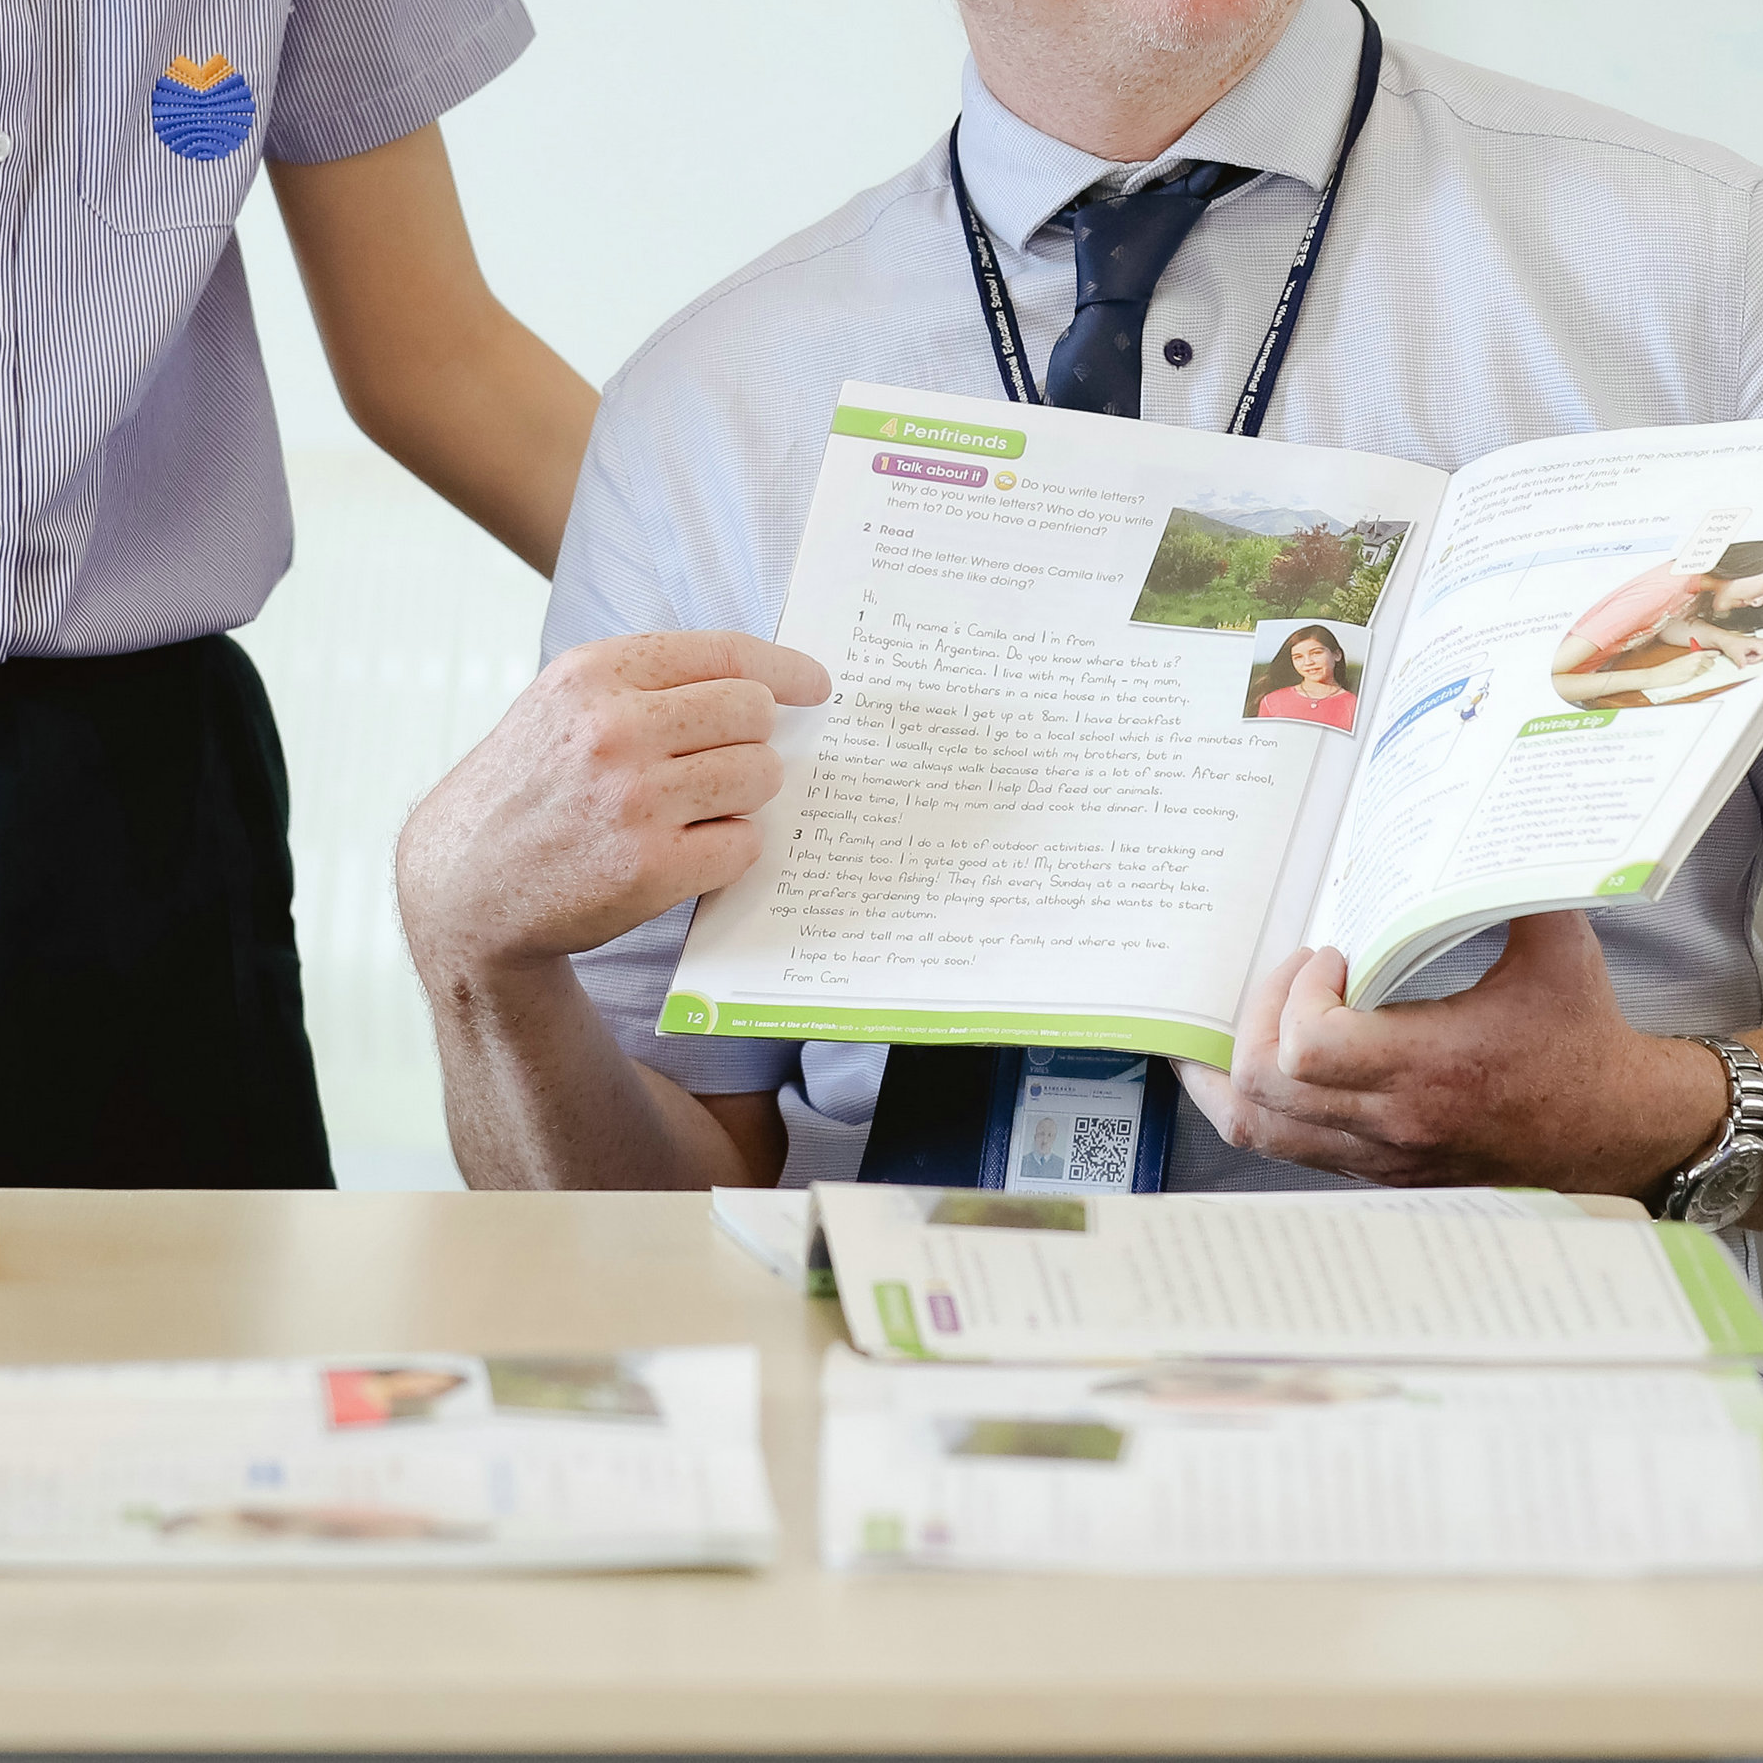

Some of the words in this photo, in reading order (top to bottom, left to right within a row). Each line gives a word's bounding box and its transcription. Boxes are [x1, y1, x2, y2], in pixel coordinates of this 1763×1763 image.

[985, 277, 1003, 309] School
[1283, 278, 1298, 302] Yew
[996, 310, 1015, 355] Education
[1247, 330, 1279, 393] International
[880, 417, 898, 437] 4
[902, 421, 1008, 451] Penfriends
[880, 456, 890, 471] 1
[895, 458, 924, 475] Talk
[925, 464, 972, 481] about
[970, 469, 982, 483] it
[1572, 458, 1595, 468] and
[891, 480, 919, 497] Why
[919, 485, 939, 498] do
[937, 489, 966, 505] you
[966, 493, 998, 507] write
[997, 496, 1045, 513] letters?
[1045, 502, 1076, 518] Who
[1076, 508, 1096, 521] do
[1097, 511, 1122, 524] you
[1124, 515, 1155, 528] write
[1020, 478, 1040, 491] Do
[1041, 482, 1067, 495] you
[1068, 486, 1099, 500] write
[1099, 489, 1146, 506] letters?
[862, 521, 873, 533] 2
[878, 524, 915, 539] Read
[886, 496, 921, 511] them
[922, 501, 944, 514] to?
[944, 504, 964, 518] Do
[965, 509, 991, 522] you
[991, 511, 1025, 527] have
[1026, 518, 1038, 528] a
[1038, 520, 1109, 537] penfriend?
[871, 557, 905, 572] What
[906, 563, 940, 577] does
[940, 567, 965, 581] she
[965, 570, 988, 584] like
[989, 574, 1036, 591] doing?
[874, 541, 910, 557] Read
[911, 547, 934, 561] the
[934, 550, 969, 566] letter.
[970, 554, 1011, 571] Where
[1012, 561, 1045, 576] does
[1046, 565, 1094, 581] Camila
[1095, 571, 1125, 584] live?
[862, 588, 878, 606] Hi,
[857, 609, 866, 623] 1
[891, 613, 912, 633] My
[966, 622, 1008, 641] Camila
[1011, 631, 1037, 644] and
[1065, 633, 1096, 648] from
[851, 628, 914, 652] Patagonia
[918, 639, 930, 652] in
[933, 637, 1001, 659] Argentina.
[1005, 644, 1024, 661] Do
[1027, 653, 1049, 666] you
[1051, 652, 1083, 665] know
[1085, 654, 1125, 668] where
[1129, 655, 1159, 669] that
[1162, 655, 1183, 669] is?
[1528, 717, 1580, 733] Writing
[1582, 715, 1605, 729] tip
[799, 808, 858, 825] especially
[861, 812, 904, 825] cakes!
[768, 905, 798, 918] yoga
[801, 904, 846, 917] classes
[848, 906, 860, 917] in
[865, 905, 887, 919] the
[890, 908, 937, 920] autumn.
[799, 924, 838, 939] Write
[840, 929, 866, 941] and
[869, 930, 893, 942] tell
[894, 933, 915, 942] me
[917, 931, 935, 942] all
[936, 930, 975, 945] about
[978, 936, 1006, 948] your
[1009, 933, 1046, 949] family
[1049, 935, 1074, 947] and
[1077, 934, 1116, 947] where
[1120, 940, 1142, 951] you
[1144, 937, 1170, 950] live.
[782, 968, 814, 984] From
[819, 970, 850, 985] Cami
